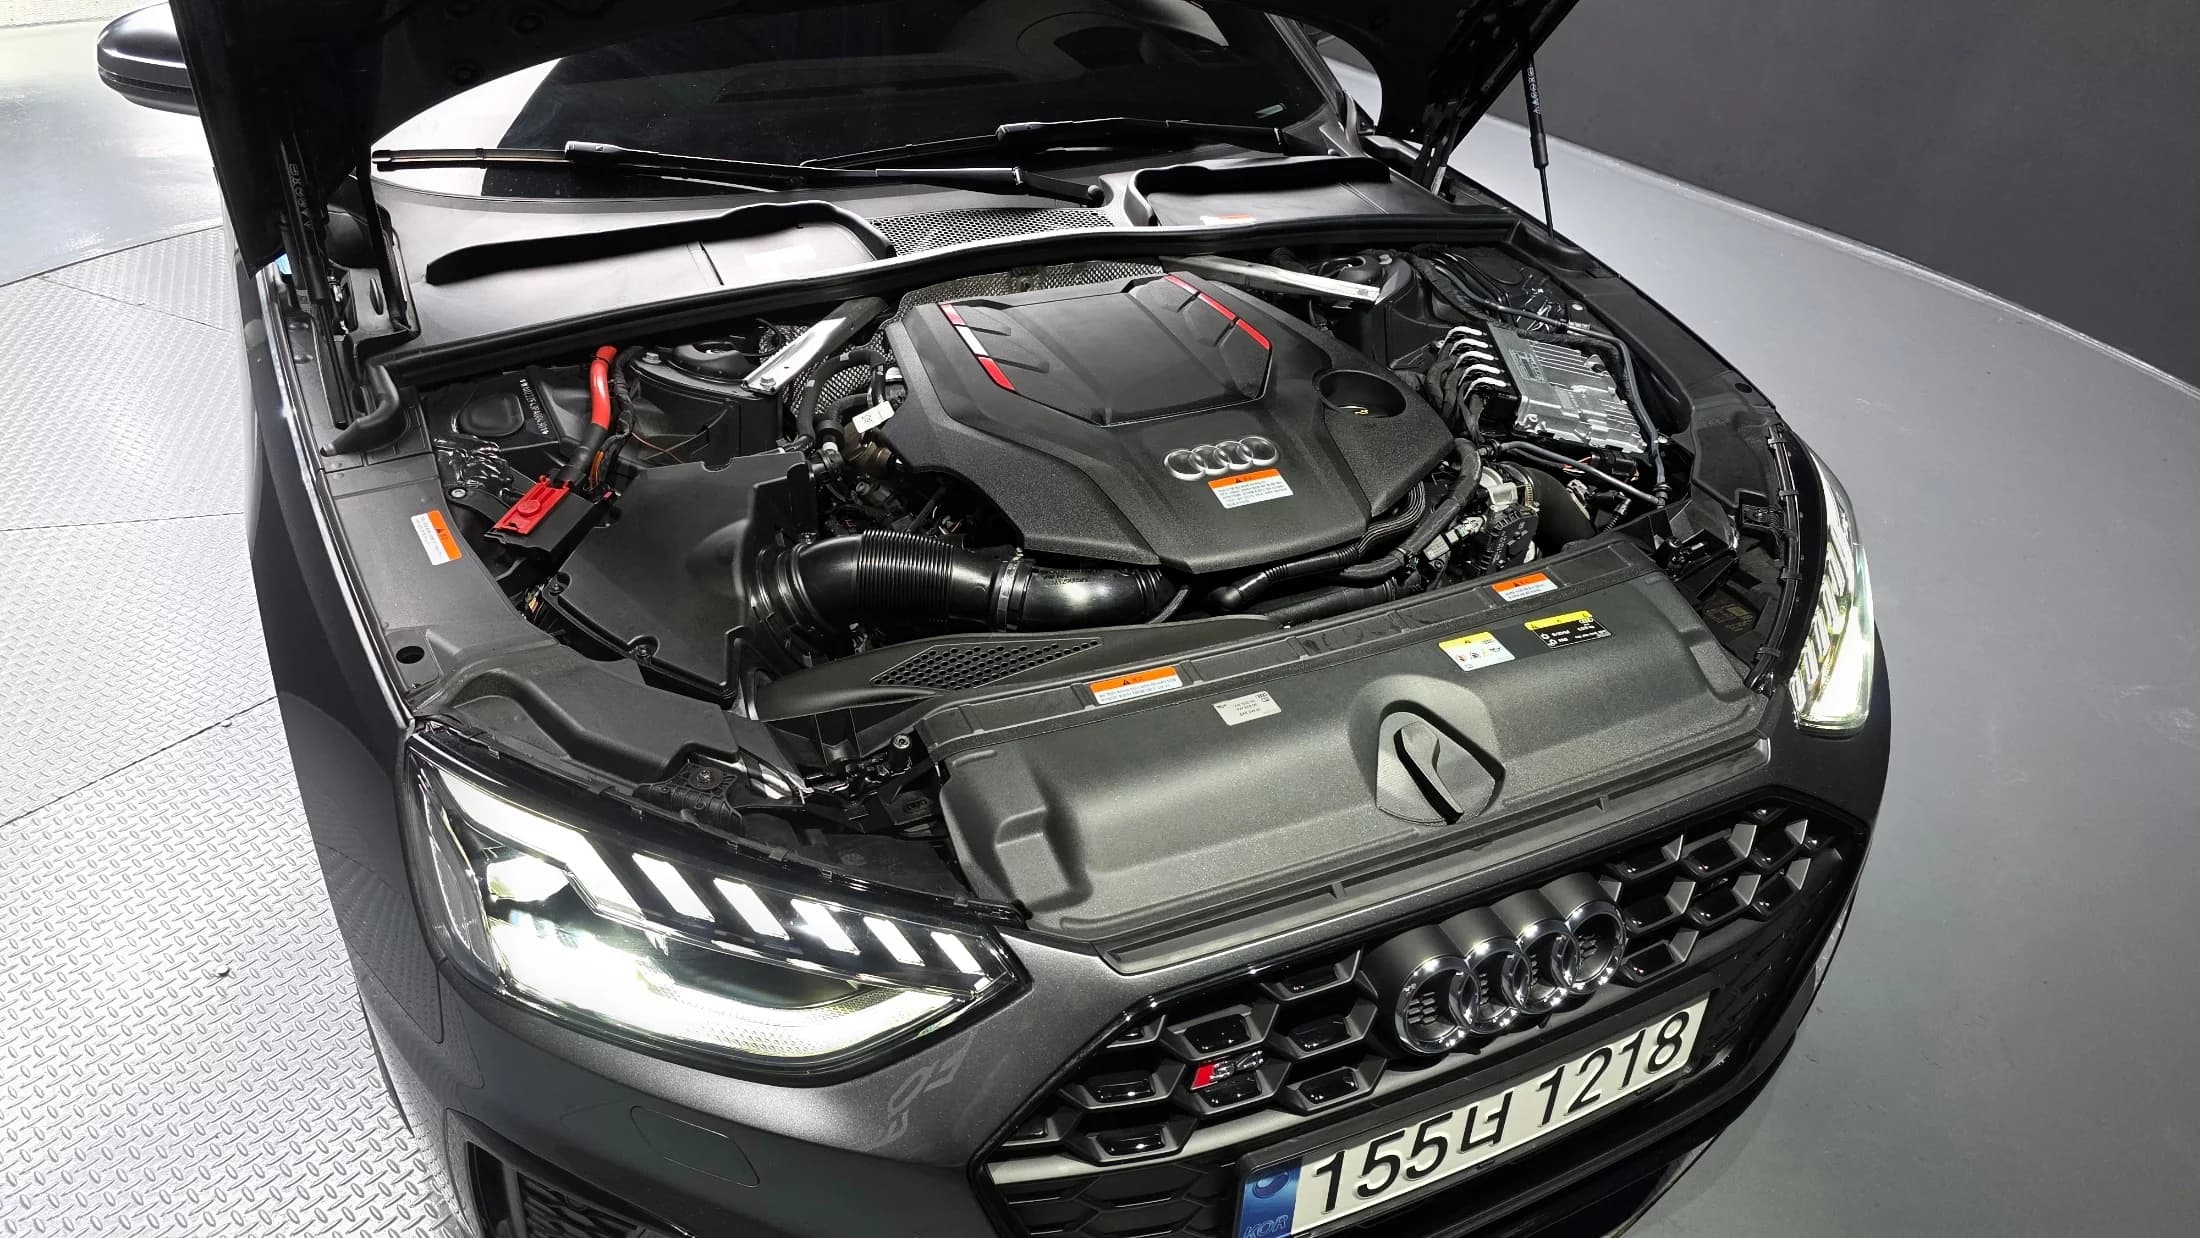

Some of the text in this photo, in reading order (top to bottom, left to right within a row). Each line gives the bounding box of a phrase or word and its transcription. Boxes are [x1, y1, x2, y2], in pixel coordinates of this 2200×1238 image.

[1315, 1011, 1690, 1213] 155너 1218
[1243, 1214, 1289, 1238] KOR
